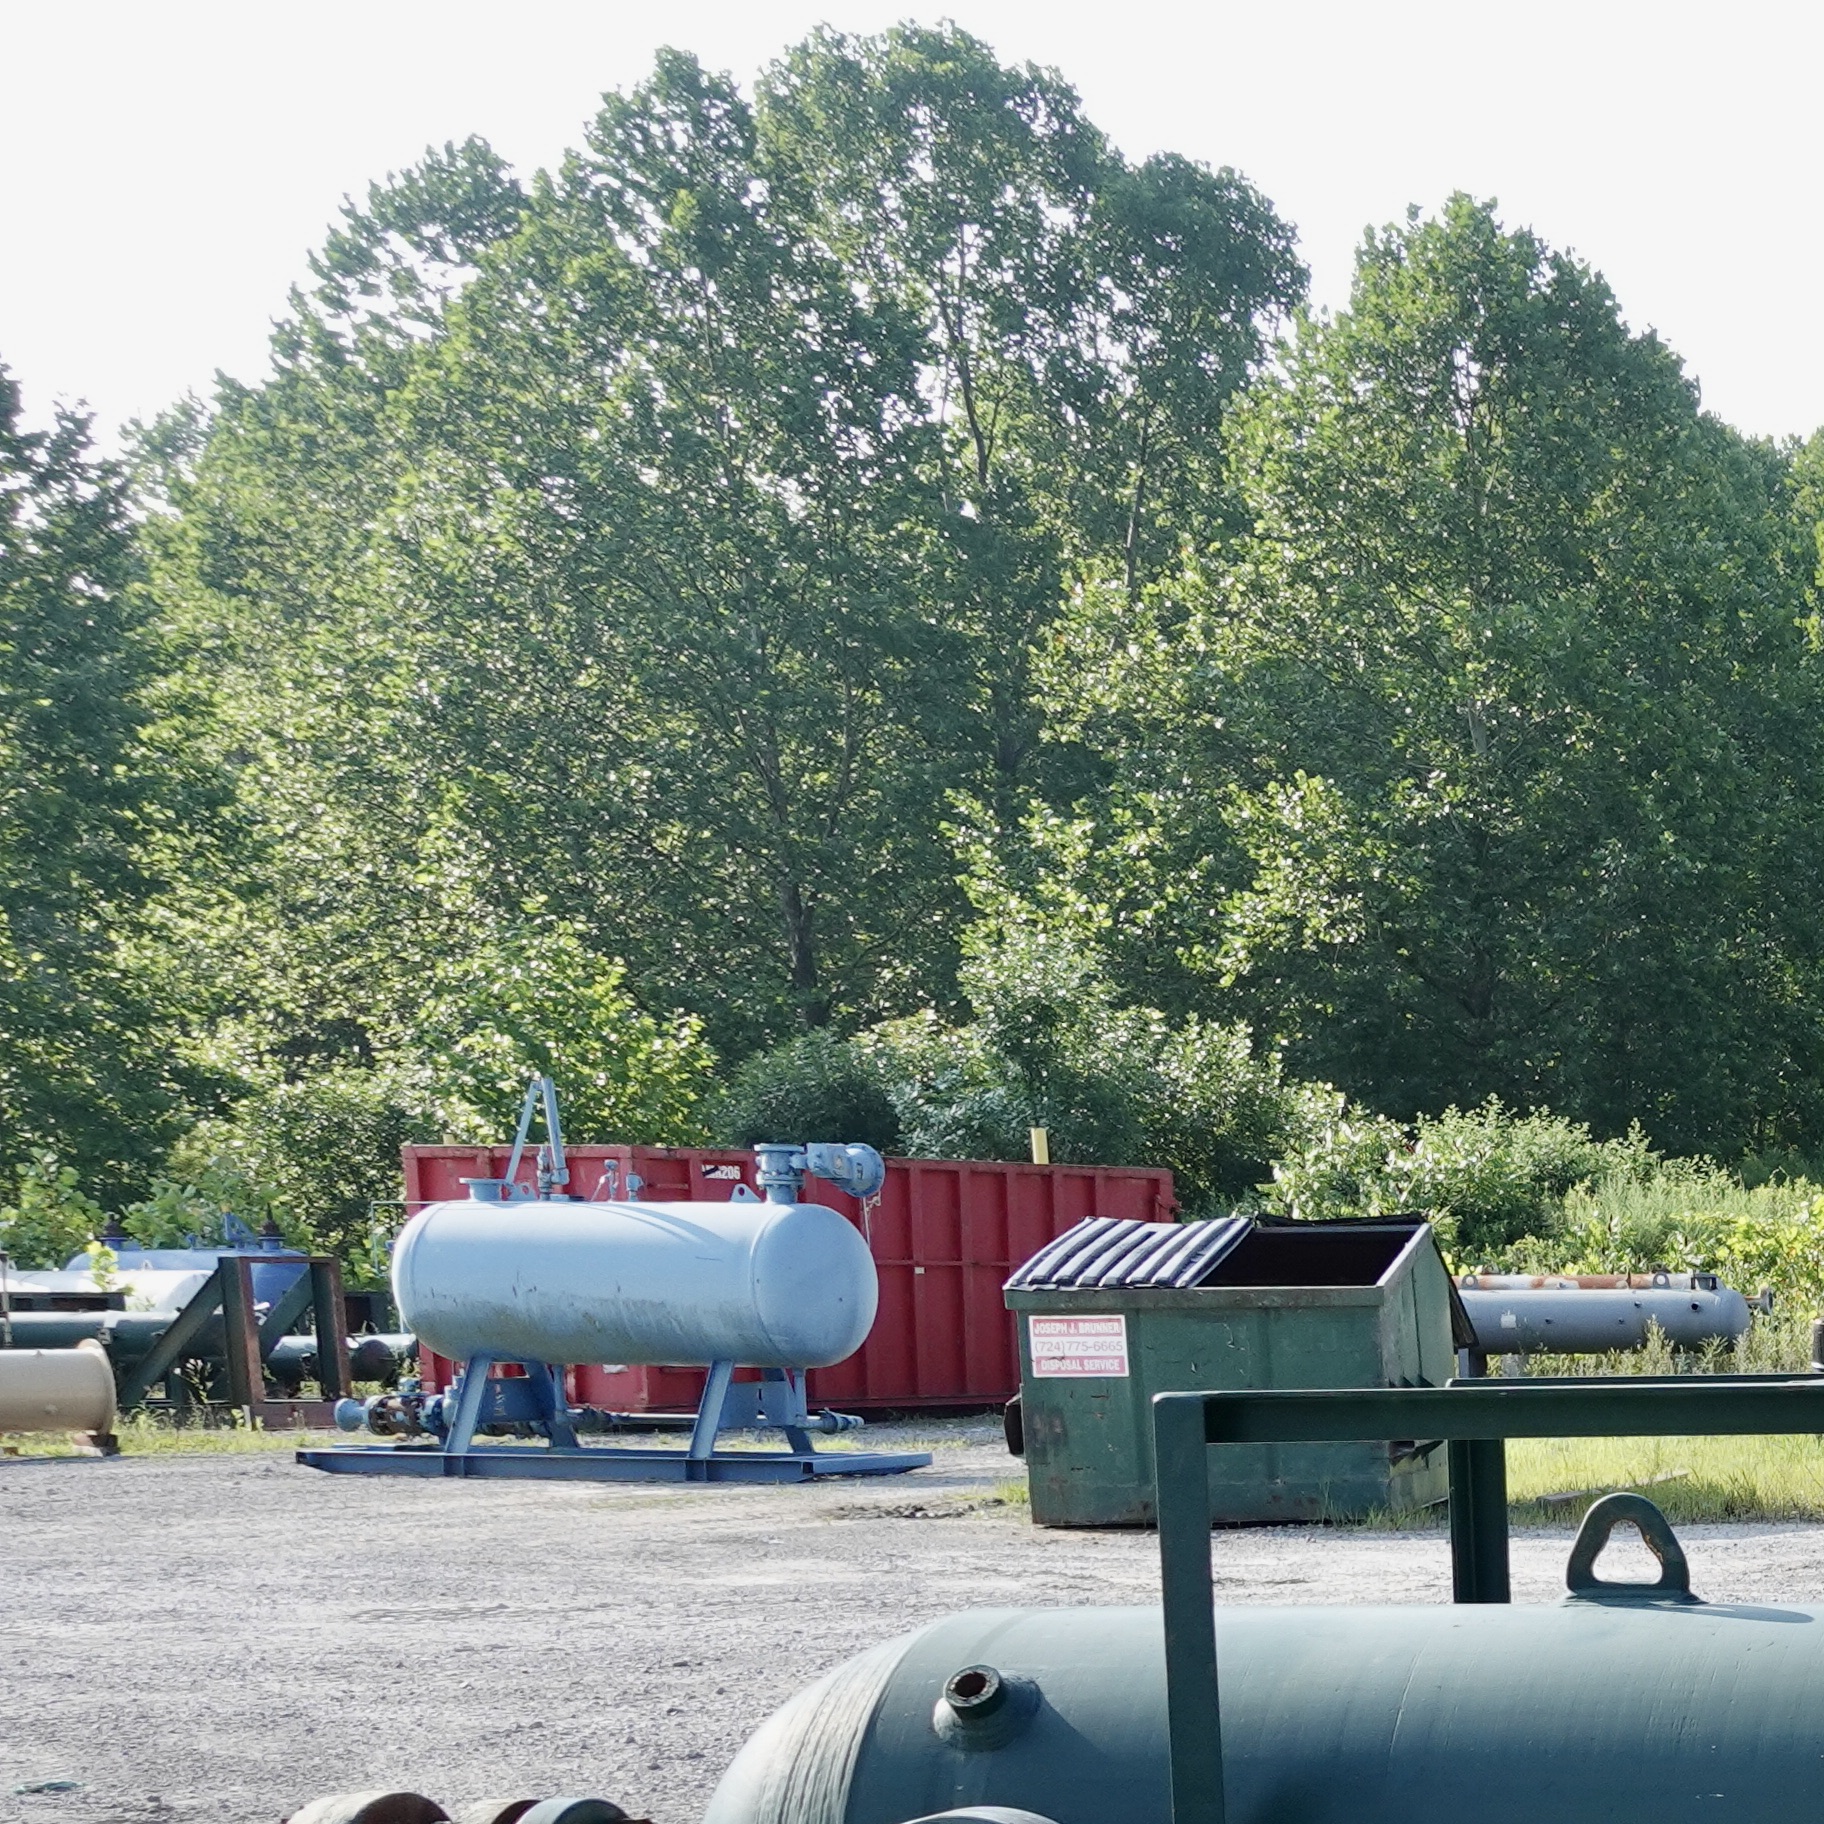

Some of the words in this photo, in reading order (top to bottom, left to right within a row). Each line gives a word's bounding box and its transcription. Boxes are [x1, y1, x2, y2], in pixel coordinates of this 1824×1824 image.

[1034, 1322, 1068, 1335] JOSEPH
[1069, 1322, 1077, 1334] J.
[1078, 1321, 1119, 1334] BRUNNER
[1041, 1358, 1083, 1371] DISPOSAL
[1083, 1358, 1120, 1371] SERVICE
